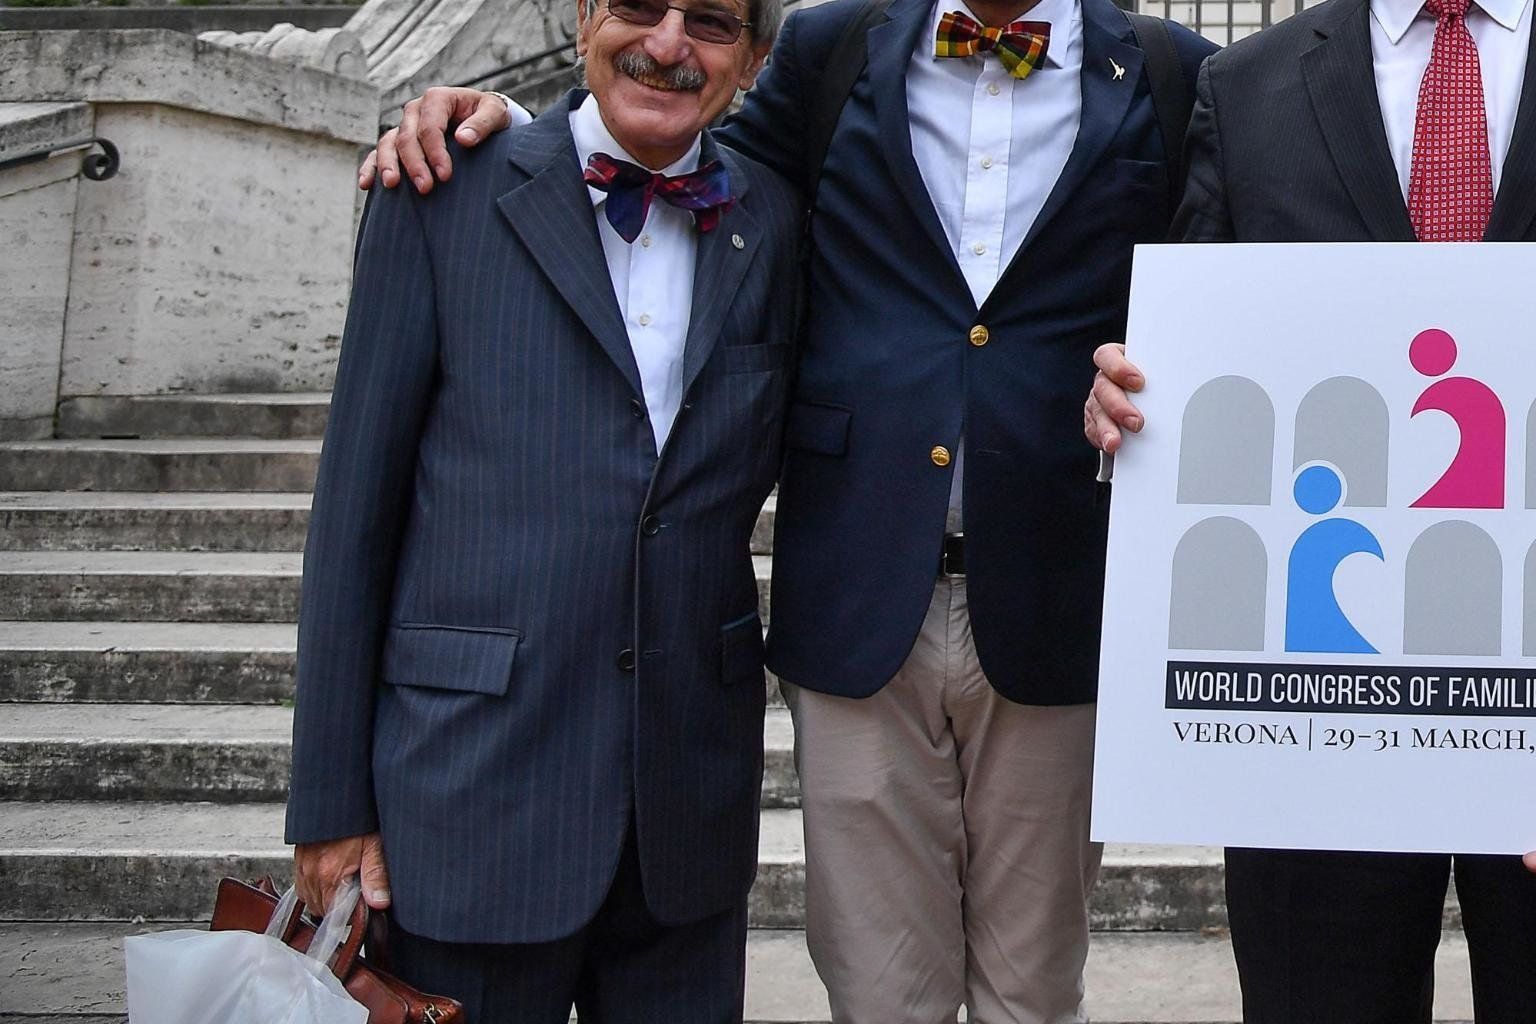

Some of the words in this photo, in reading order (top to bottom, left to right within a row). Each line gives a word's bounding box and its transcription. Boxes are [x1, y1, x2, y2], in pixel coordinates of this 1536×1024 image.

[1174, 670, 1263, 703] WORLD
[1270, 673, 1401, 706] CONGRESS
[1409, 676, 1440, 707] OF
[1173, 721, 1299, 745] VERONA
[1323, 728, 1401, 751] 29-31
[1411, 727, 1535, 754] MARCH,
